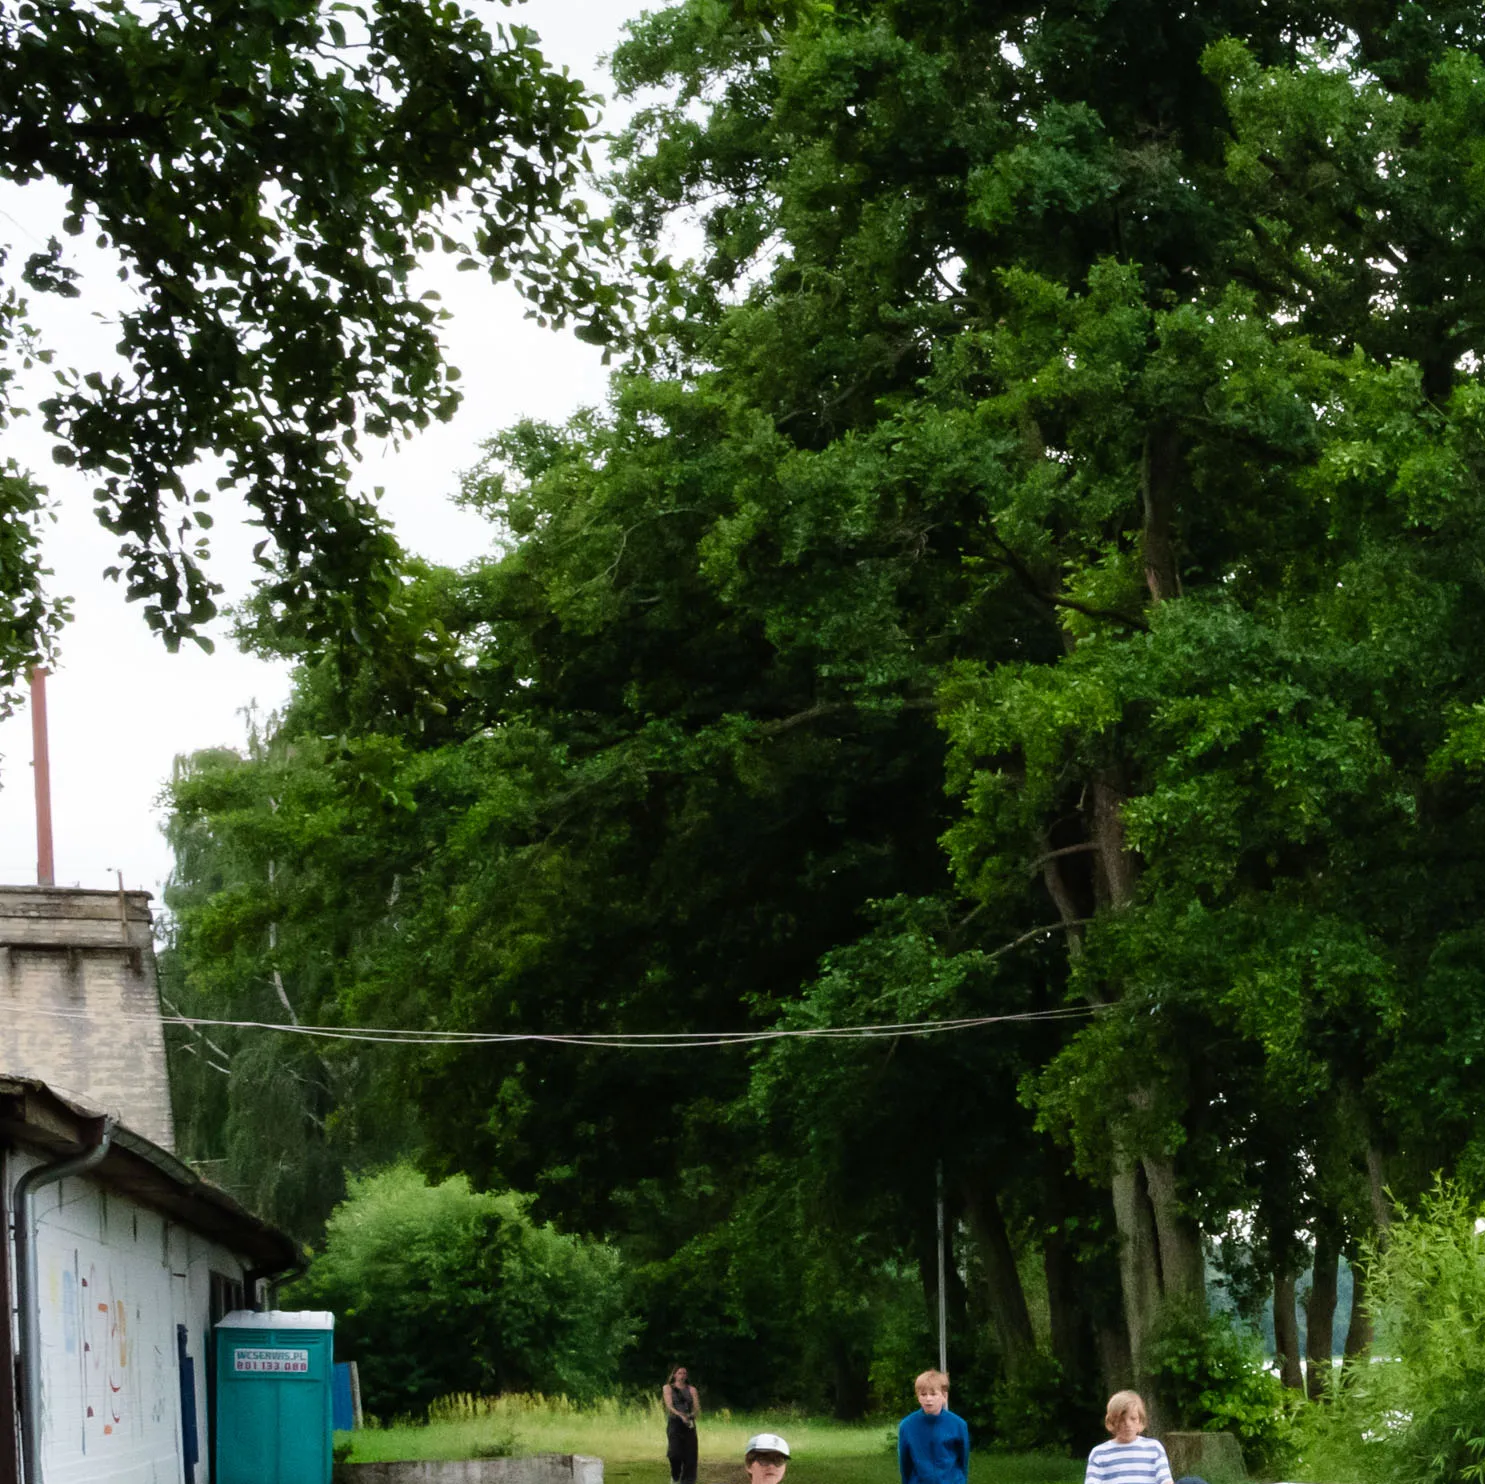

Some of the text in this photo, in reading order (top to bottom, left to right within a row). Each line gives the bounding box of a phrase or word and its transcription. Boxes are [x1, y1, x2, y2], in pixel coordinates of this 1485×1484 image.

[236, 1351, 307, 1360] WCSERWIS.PL
[237, 1361, 257, 1370] 801
[262, 1361, 280, 1370] 133
